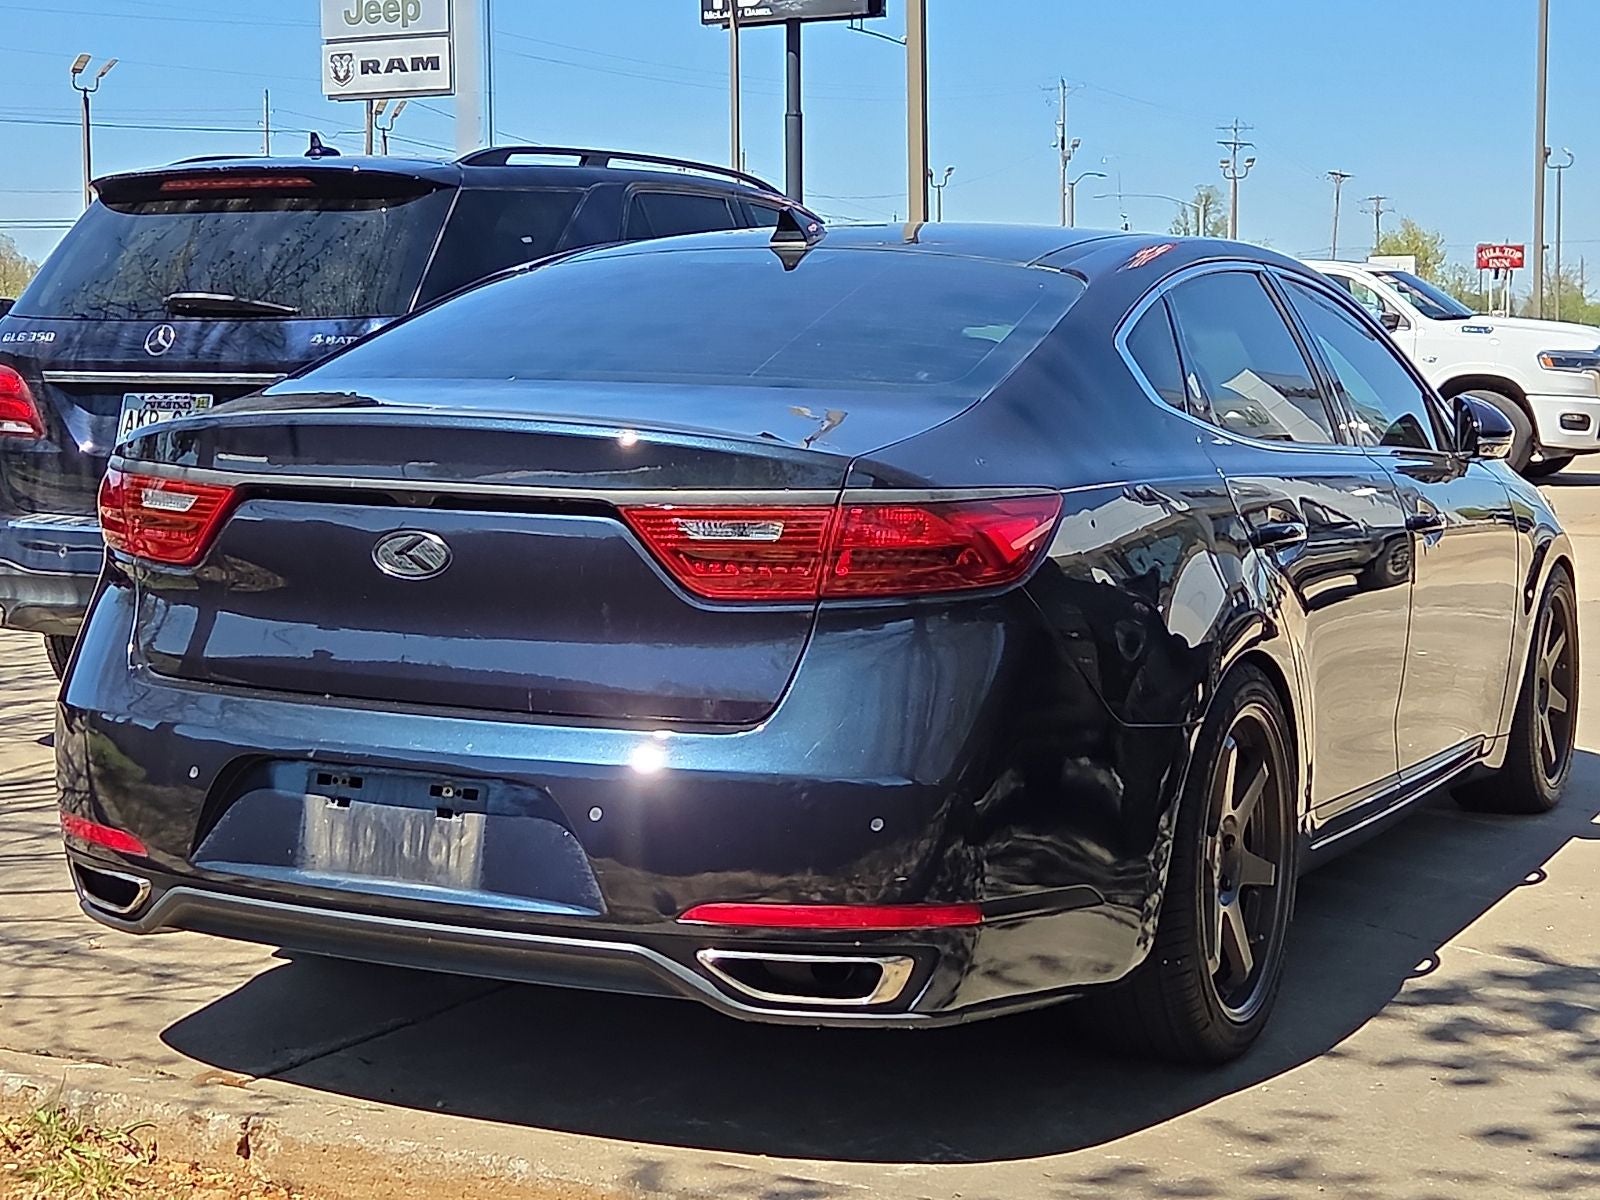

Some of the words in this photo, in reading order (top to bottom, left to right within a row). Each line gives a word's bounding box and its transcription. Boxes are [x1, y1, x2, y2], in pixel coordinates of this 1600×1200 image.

[343, 0, 421, 28] Jeep
[360, 56, 440, 75] RAM
[1478, 247, 1502, 260] HILL
[1503, 247, 1523, 259] TOP
[1488, 258, 1511, 268] INN
[28, 331, 56, 342] 350
